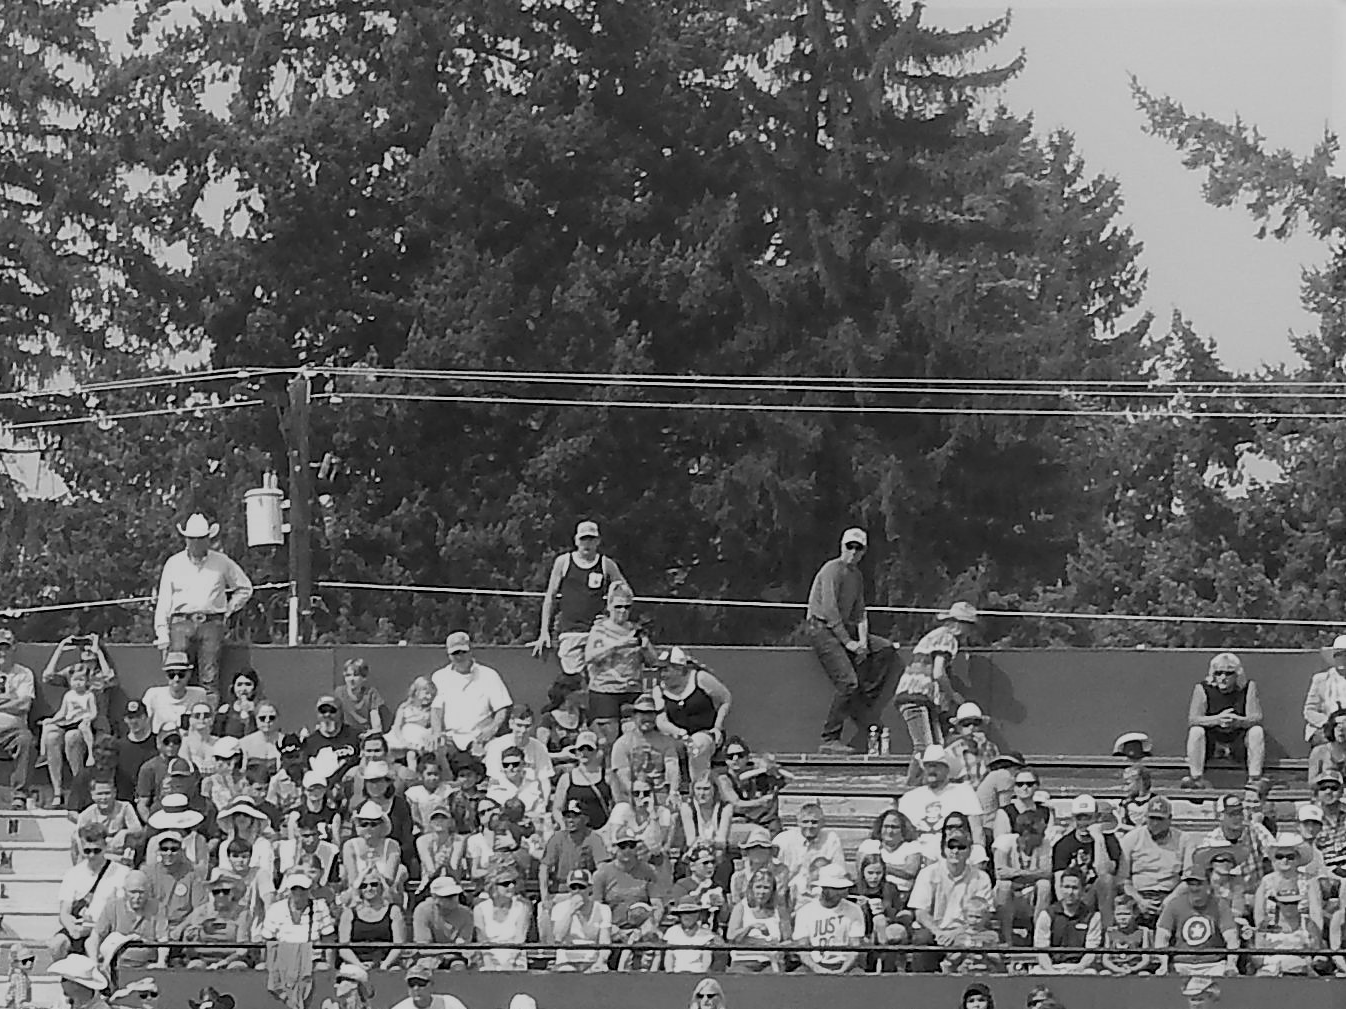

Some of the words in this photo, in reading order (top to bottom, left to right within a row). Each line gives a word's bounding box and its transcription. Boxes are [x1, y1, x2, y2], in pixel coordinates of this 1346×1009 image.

[8, 819, 19, 834] N
[0, 851, 13, 868] M
[0, 883, 9, 898] L
[813, 914, 845, 937] JUST
